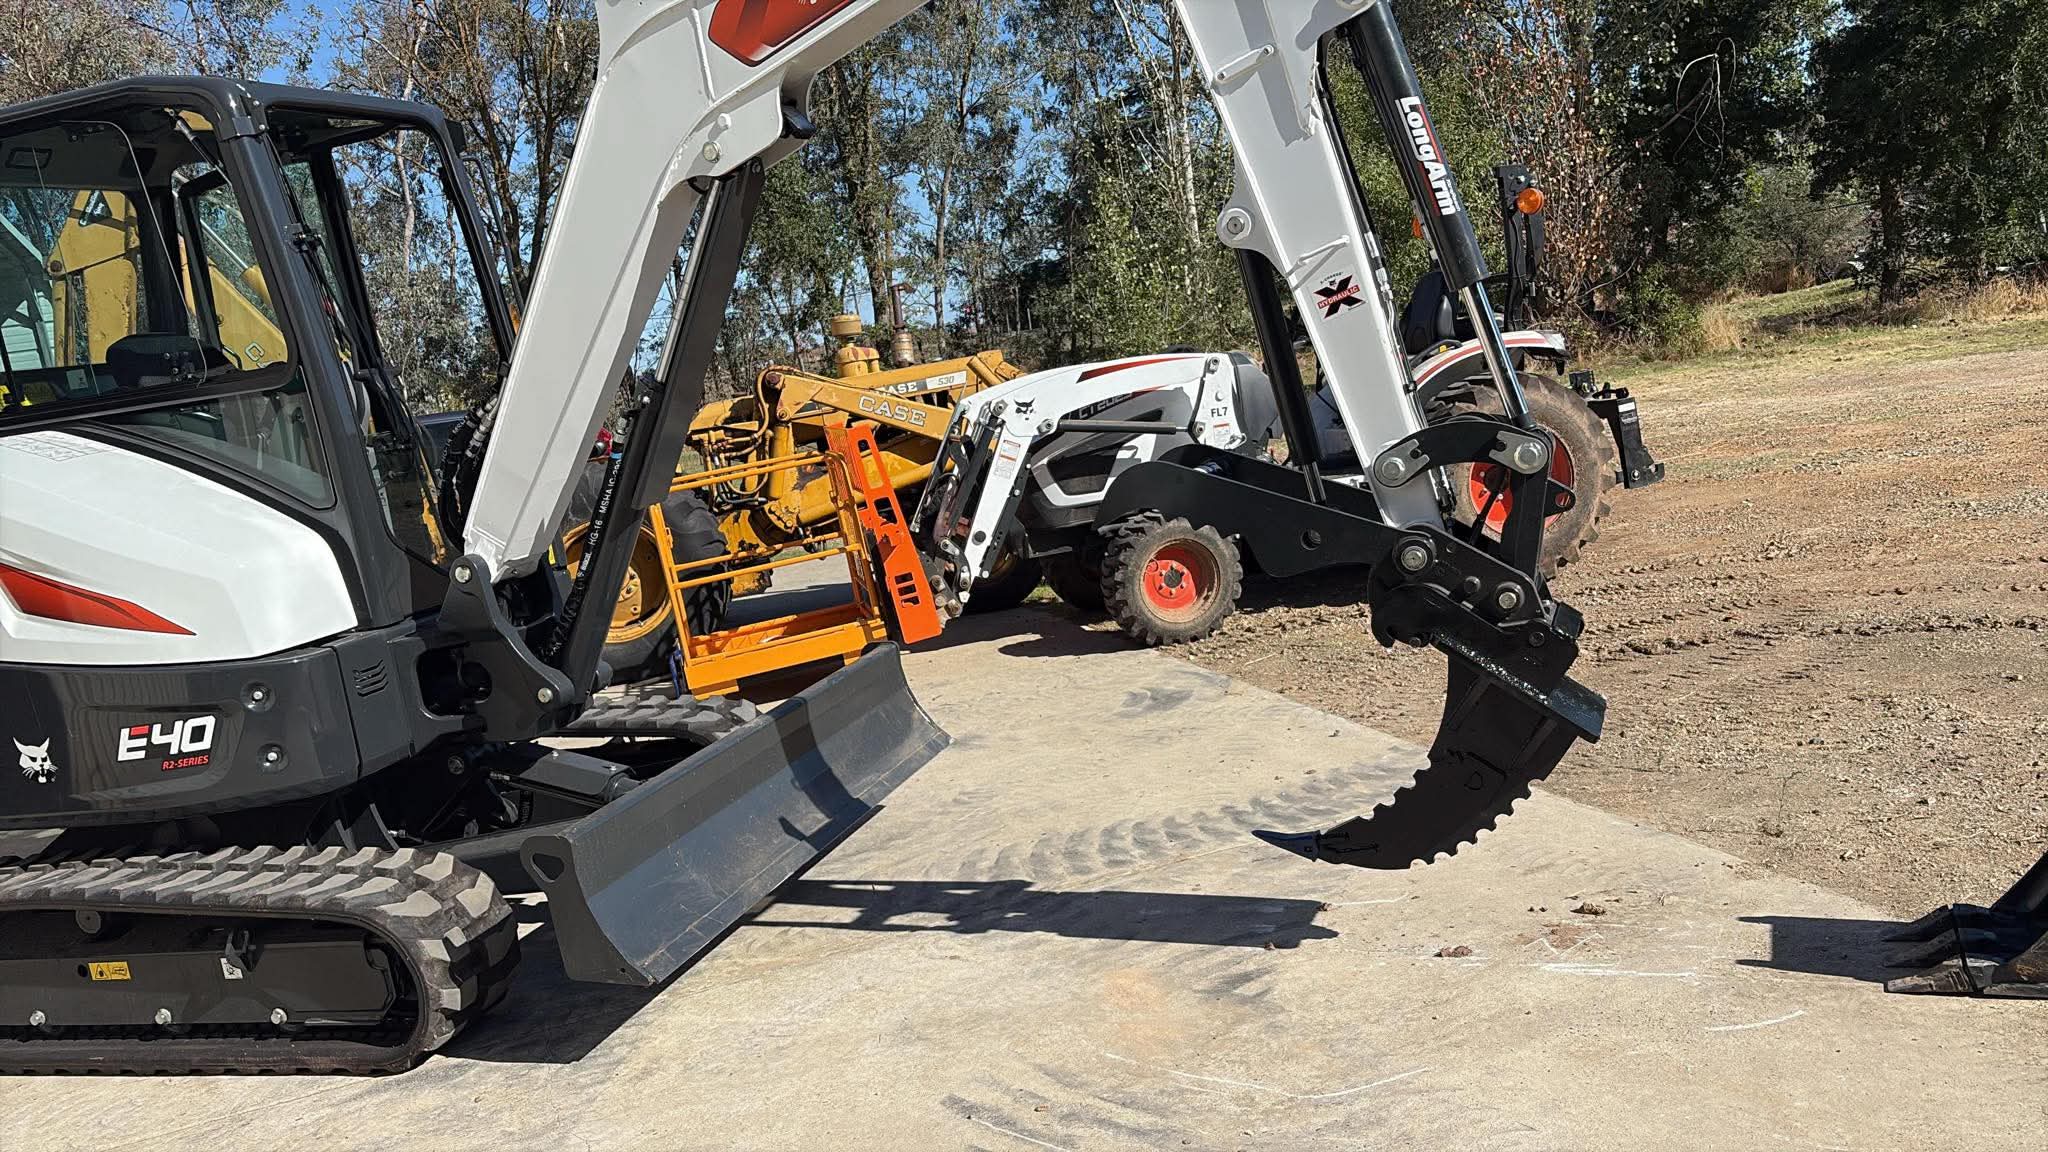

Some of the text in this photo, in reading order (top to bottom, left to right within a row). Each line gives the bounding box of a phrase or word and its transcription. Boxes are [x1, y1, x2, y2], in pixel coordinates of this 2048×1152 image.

[1395, 96, 1456, 216] LongArm
[1318, 285, 1359, 308] HYDRAULIC
[937, 375, 955, 386] 530
[859, 395, 926, 427] CASE
[1210, 406, 1228, 418] FL7
[588, 519, 604, 546] HG-16
[598, 488, 613, 514] MSHA
[117, 715, 216, 761] E40
[162, 755, 209, 770] R2-SERIES
